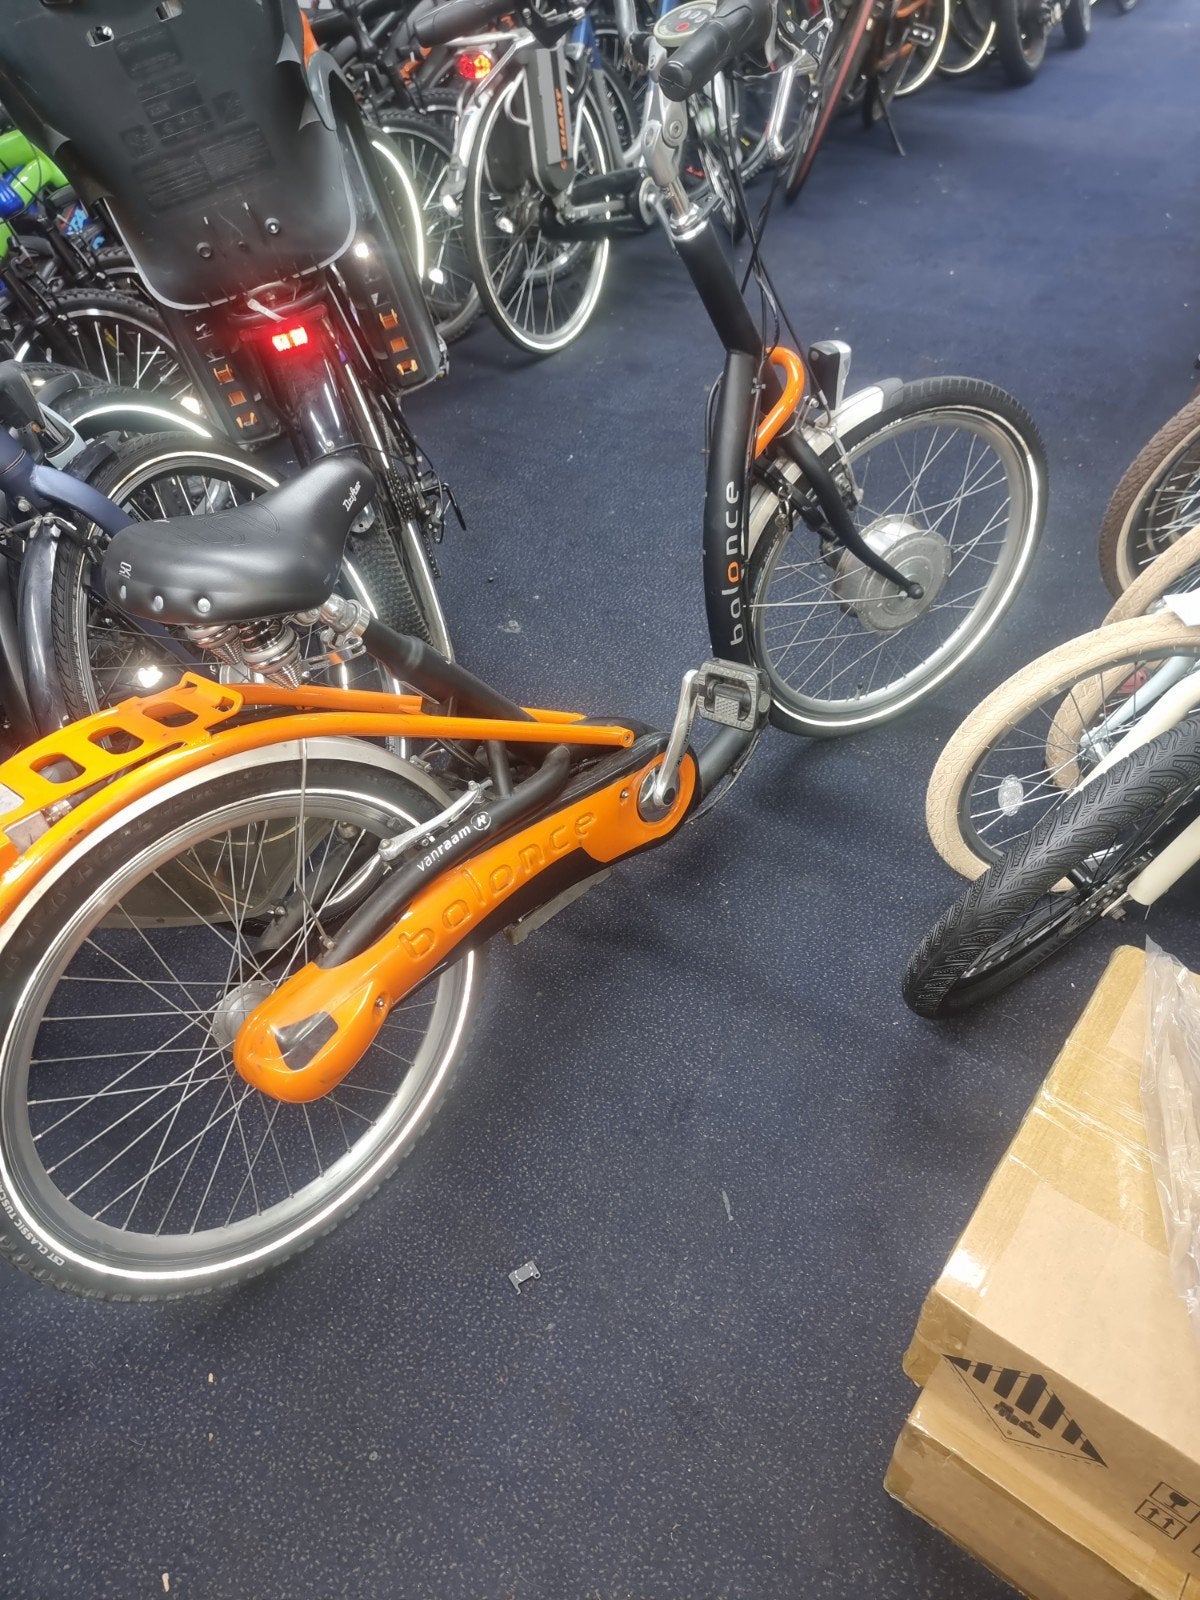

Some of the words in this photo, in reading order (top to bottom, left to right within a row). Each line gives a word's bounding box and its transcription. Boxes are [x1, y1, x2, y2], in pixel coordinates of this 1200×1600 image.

[416, 824, 471, 872] vanraam
[13, 1217, 49, 1255] CLASSIC
[46, 1252, 65, 1266] CST
